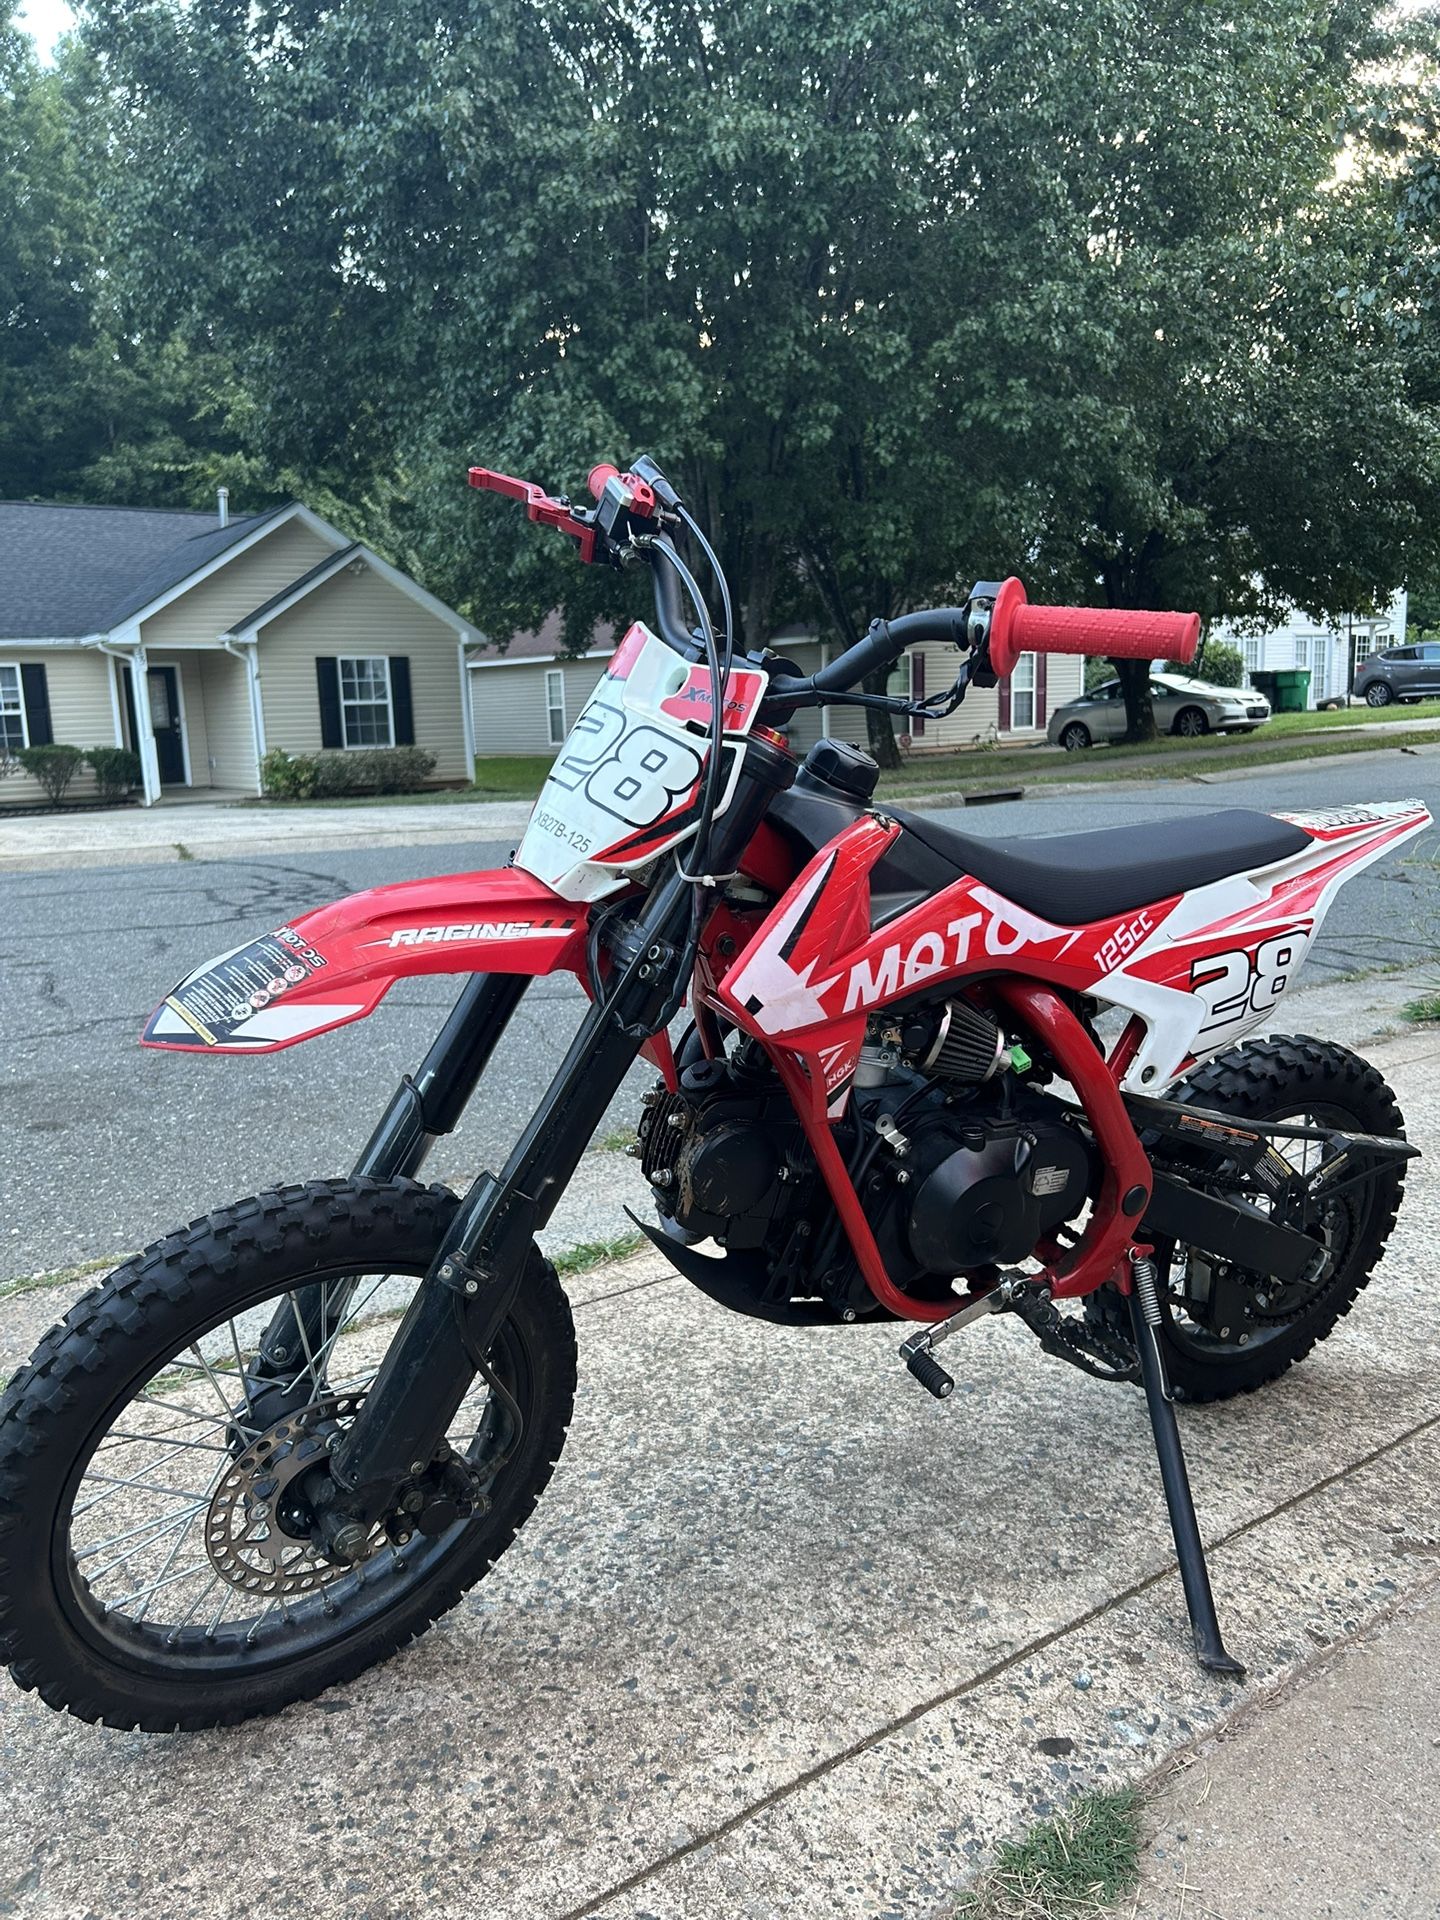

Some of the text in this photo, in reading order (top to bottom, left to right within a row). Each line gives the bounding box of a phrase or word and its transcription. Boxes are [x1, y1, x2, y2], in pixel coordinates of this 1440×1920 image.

[548, 700, 703, 829] 28
[534, 810, 592, 853] XB27B-125
[389, 922, 530, 948] RACING
[842, 885, 1062, 1014] MOTO
[1189, 929, 1311, 1034] 28
[827, 1059, 853, 1086] NGK
